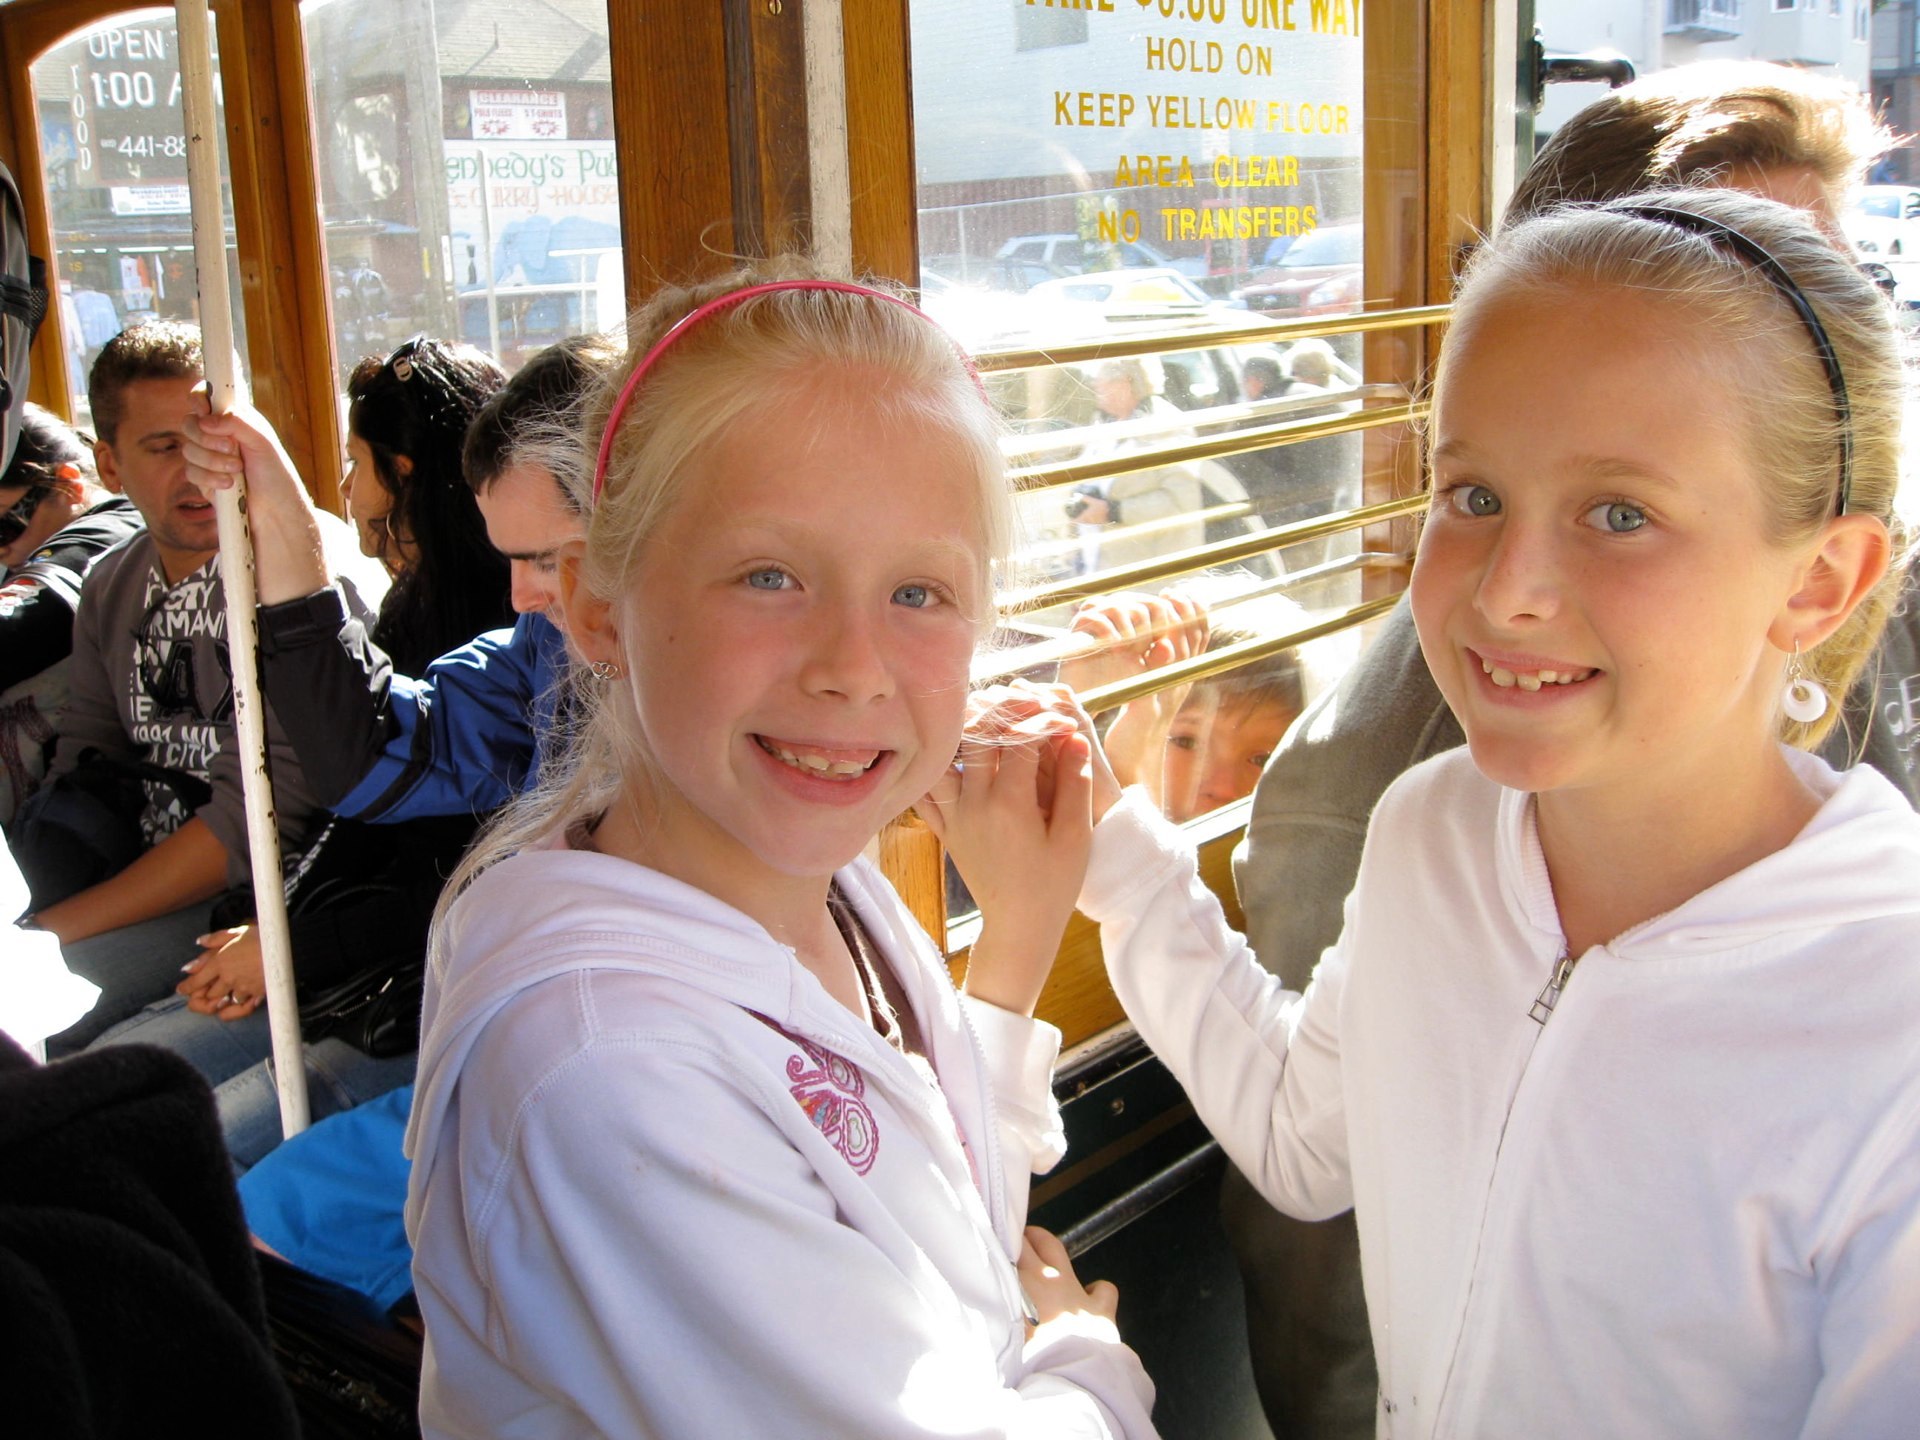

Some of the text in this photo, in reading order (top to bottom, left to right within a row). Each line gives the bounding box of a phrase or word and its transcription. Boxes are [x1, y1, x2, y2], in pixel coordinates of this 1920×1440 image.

[88, 29, 166, 60] OPEN
[1146, 36, 1272, 76] HOLD ON
[1054, 91, 1350, 134] KEEP YELLOW FLOOR
[1114, 155, 1299, 188] AREA CLEAR
[1098, 205, 1318, 244] NO TRANSFERS
